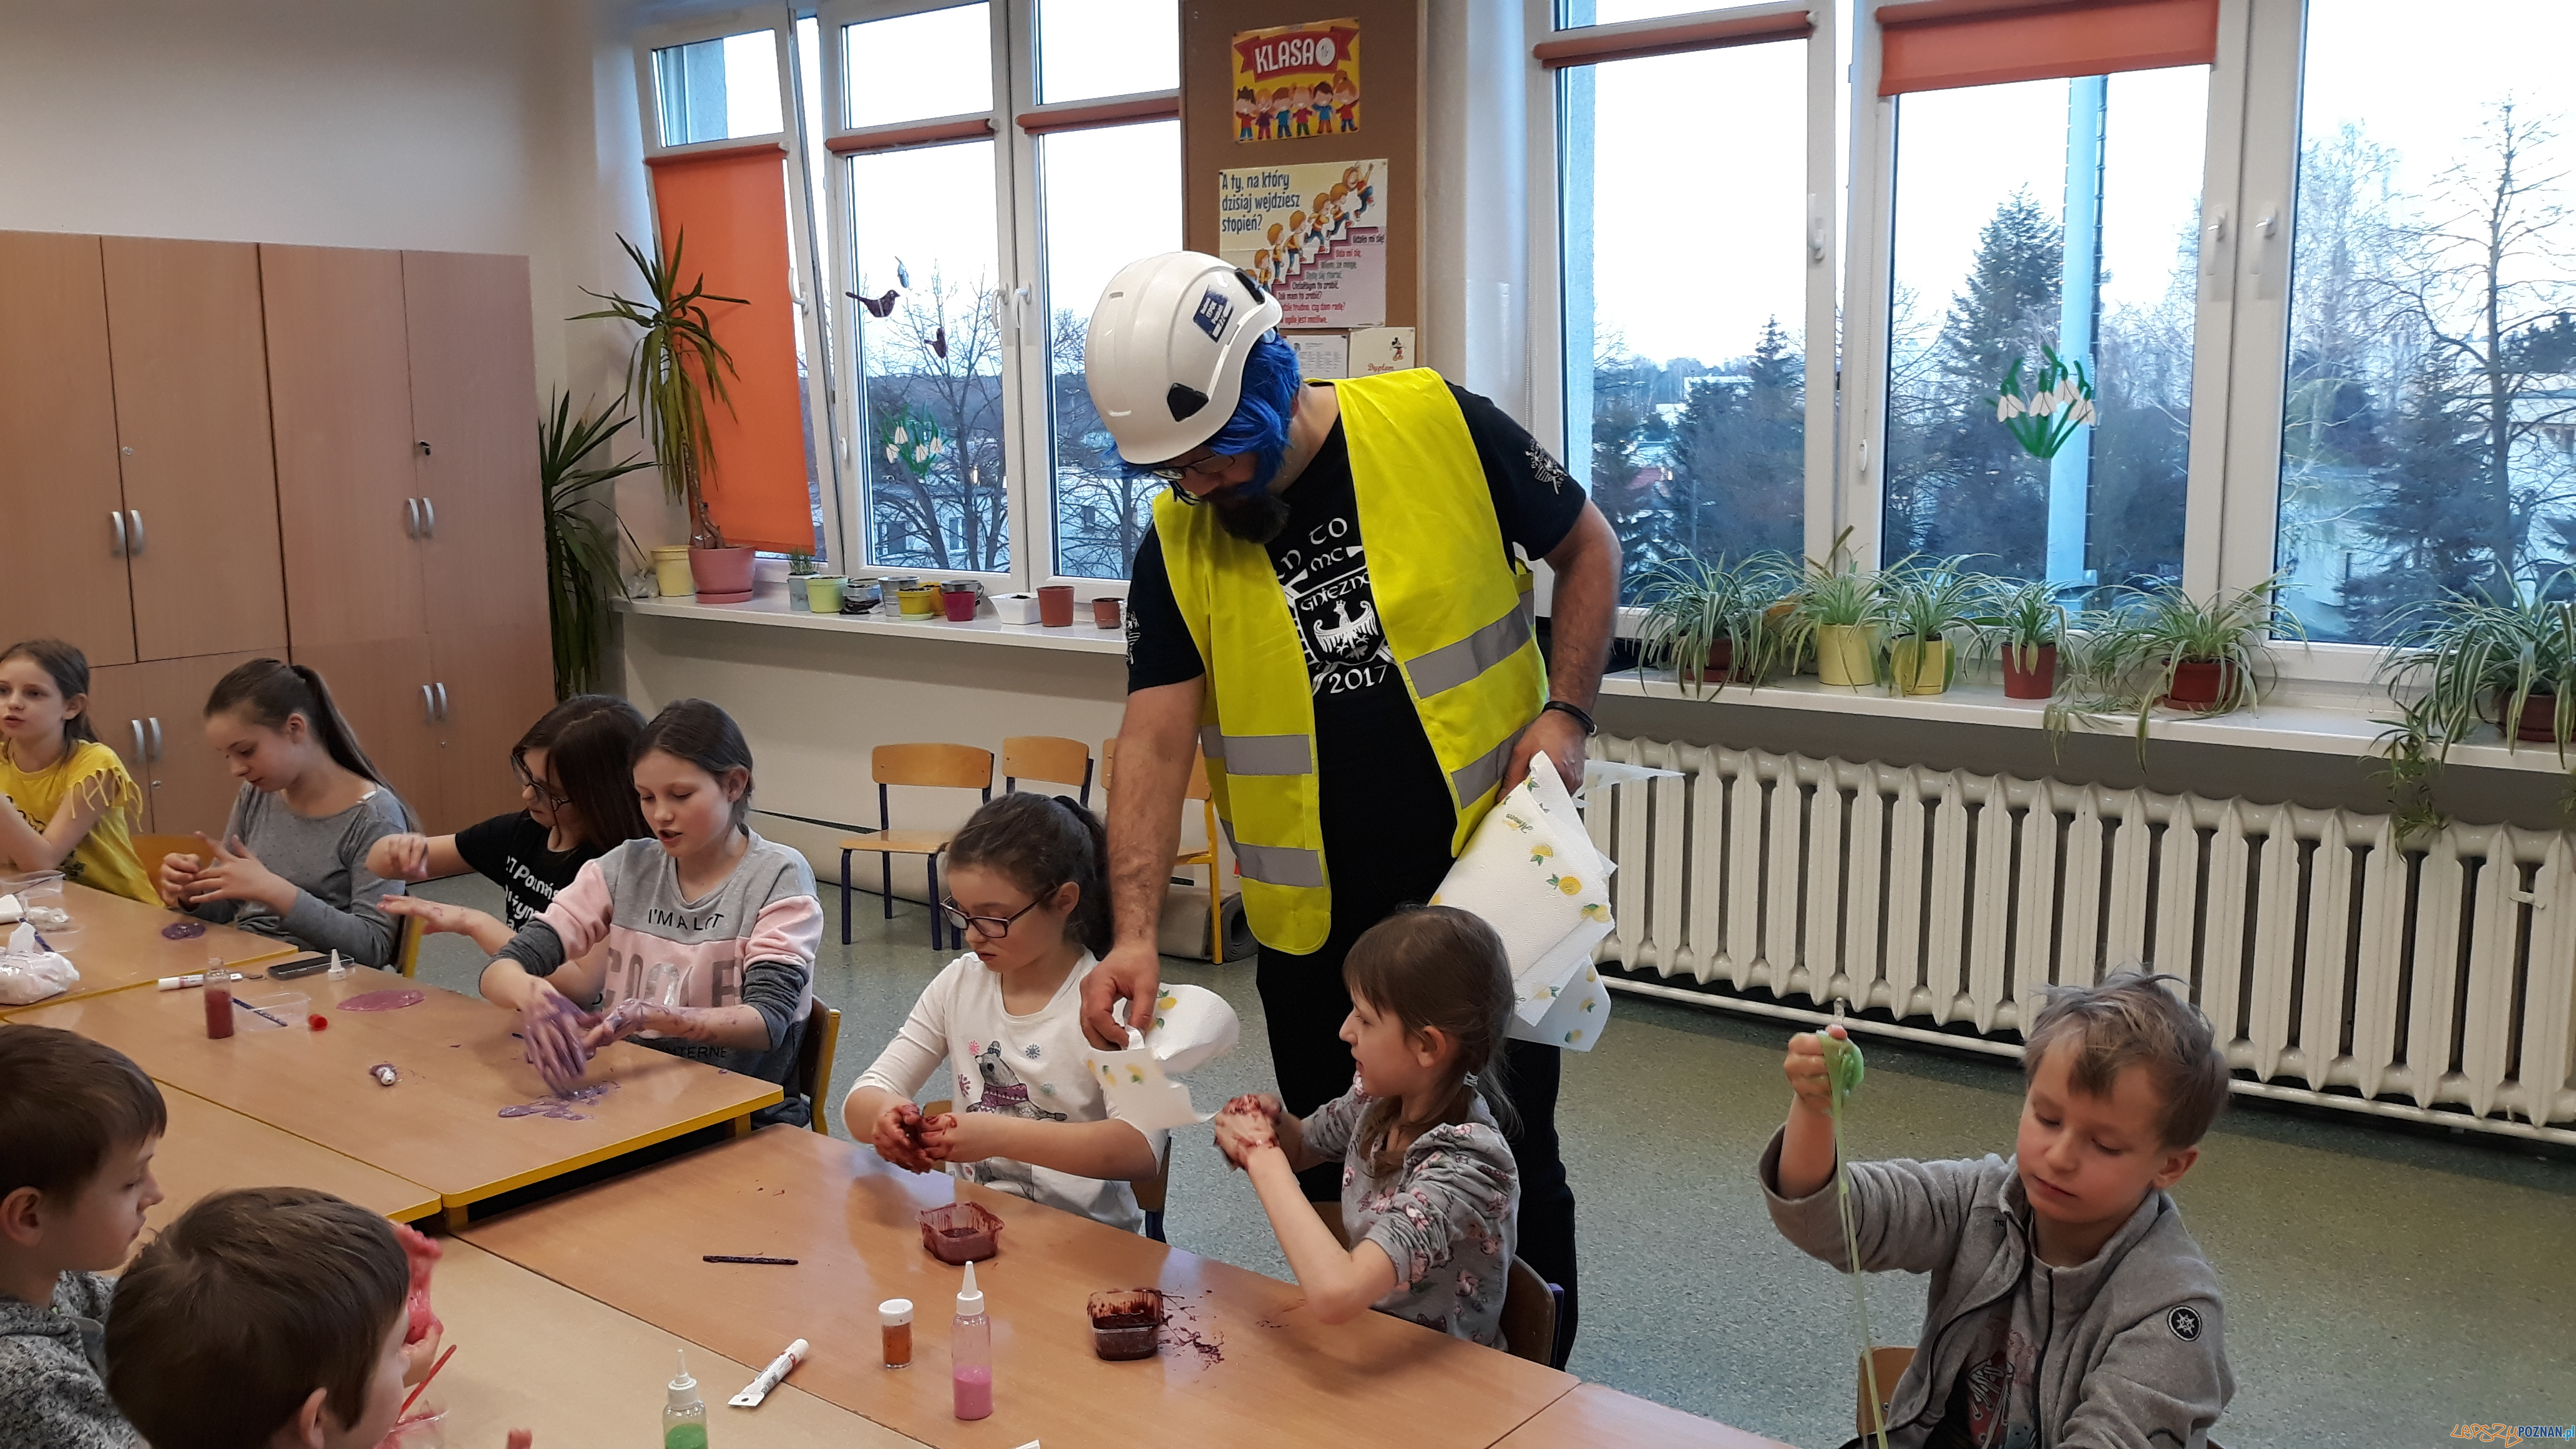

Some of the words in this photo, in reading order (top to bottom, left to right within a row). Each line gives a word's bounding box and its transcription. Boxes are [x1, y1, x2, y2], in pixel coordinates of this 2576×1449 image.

[1255, 38, 1315, 74] KLASA
[1222, 174, 1228, 190] A
[1231, 174, 1244, 193] ty,
[1246, 175, 1259, 188] na
[1262, 170, 1289, 190] który
[1222, 193, 1252, 213] dzisiaj
[1255, 191, 1300, 212] wejdziesz
[1222, 213, 1262, 235] stopień?
[1329, 664, 1388, 694] 2017
[648, 909, 673, 927] I'M
[676, 915, 688, 930] A
